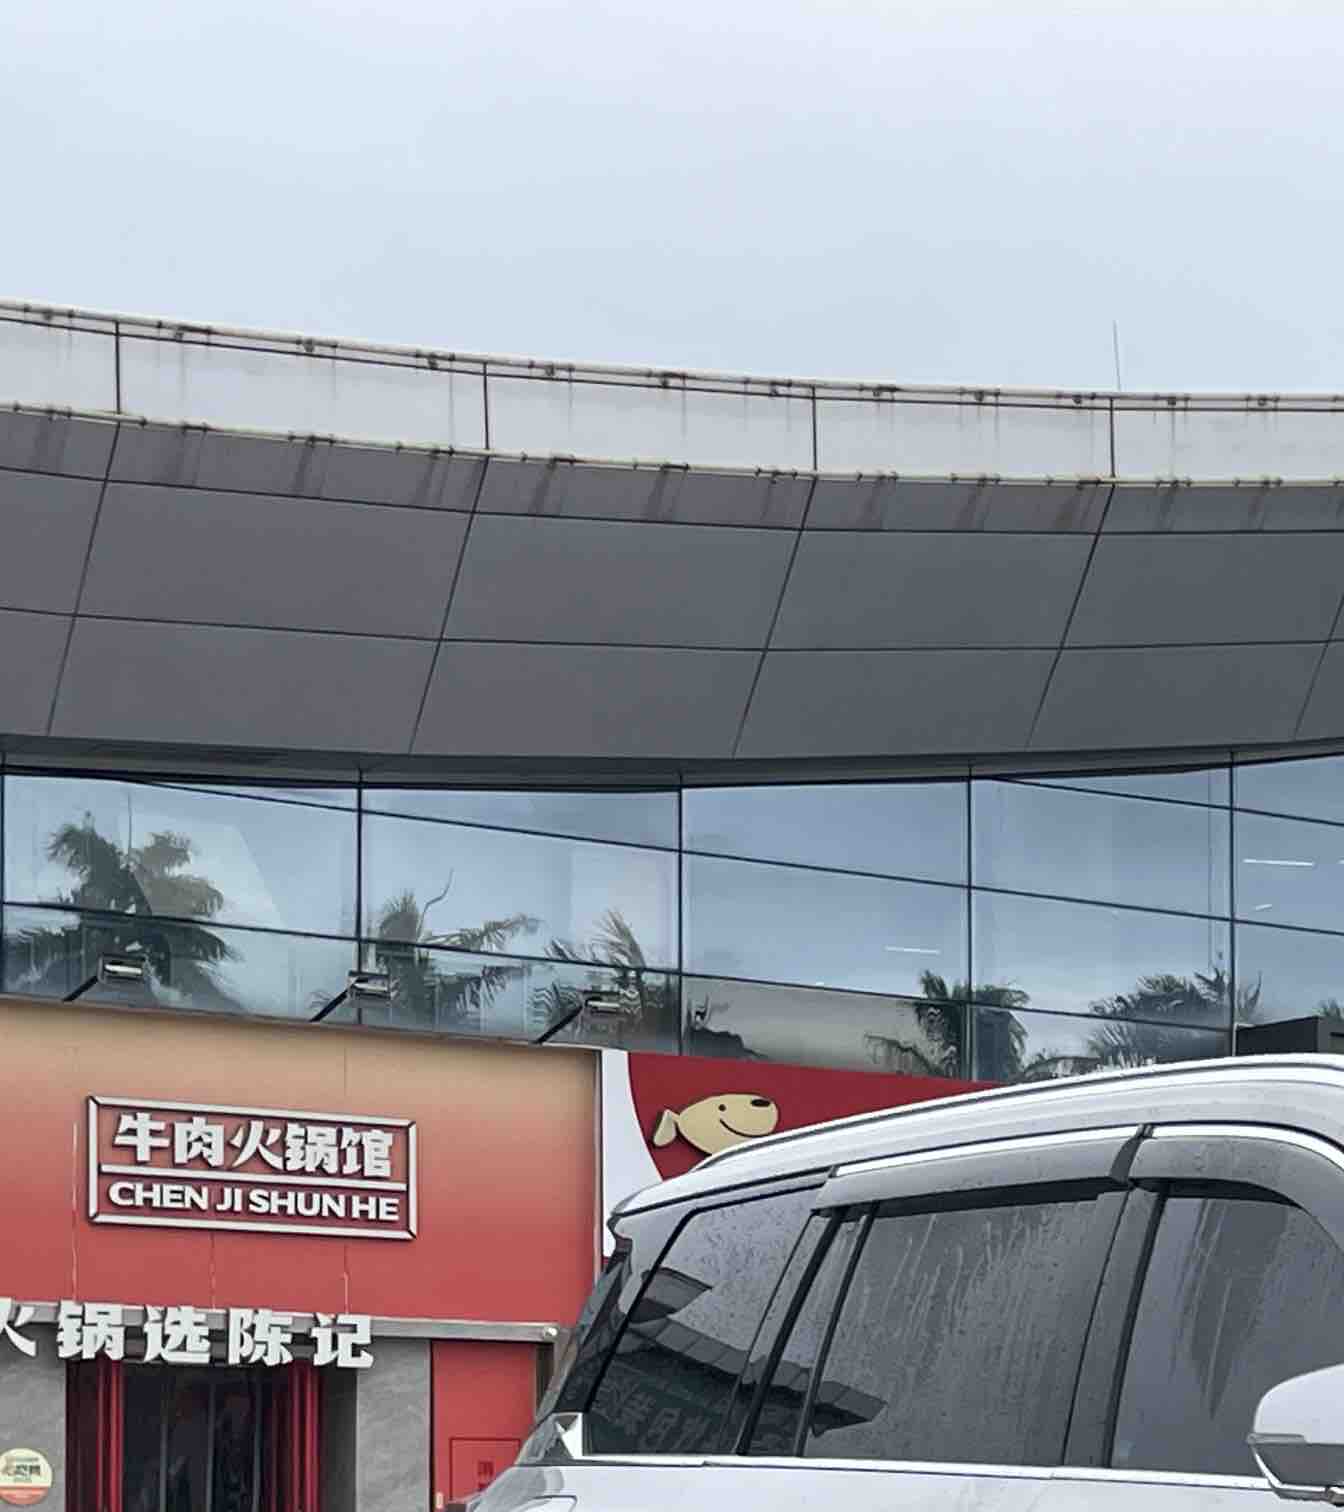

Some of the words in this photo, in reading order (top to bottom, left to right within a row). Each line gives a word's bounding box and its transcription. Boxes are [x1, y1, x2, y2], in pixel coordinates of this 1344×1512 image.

[113, 1111, 394, 1178] 牛肉火锅馆
[107, 1181, 209, 1212] CHEN
[215, 1186, 243, 1212] JI
[248, 1188, 346, 1219] SHUN
[350, 1195, 400, 1222] HE
[0, 1297, 374, 1369] 火锅选陈记
